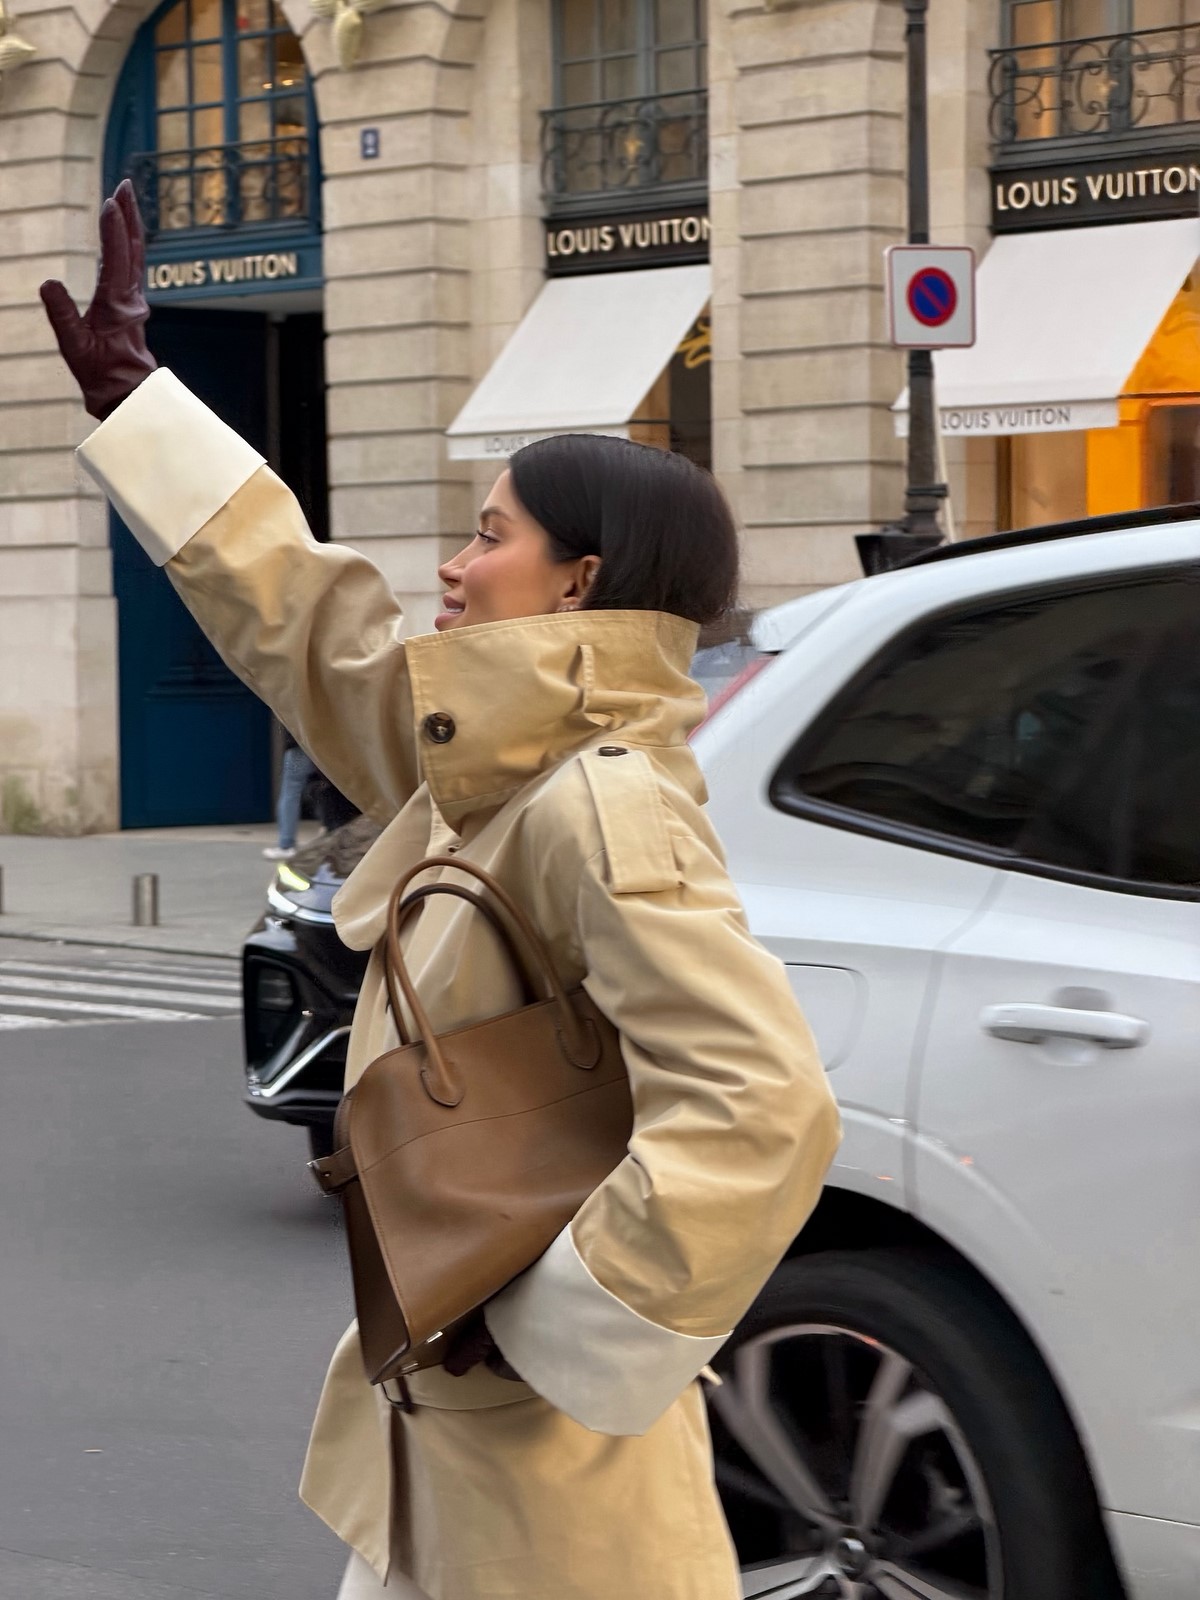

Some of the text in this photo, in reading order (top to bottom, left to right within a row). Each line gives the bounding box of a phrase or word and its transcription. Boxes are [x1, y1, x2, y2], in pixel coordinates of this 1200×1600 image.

[996, 177, 1077, 210] LOUIS
[547, 225, 614, 256] LOUIS
[148, 252, 297, 289] LOUIS VUITTON
[941, 406, 1071, 430] LOUIS VUITTON
